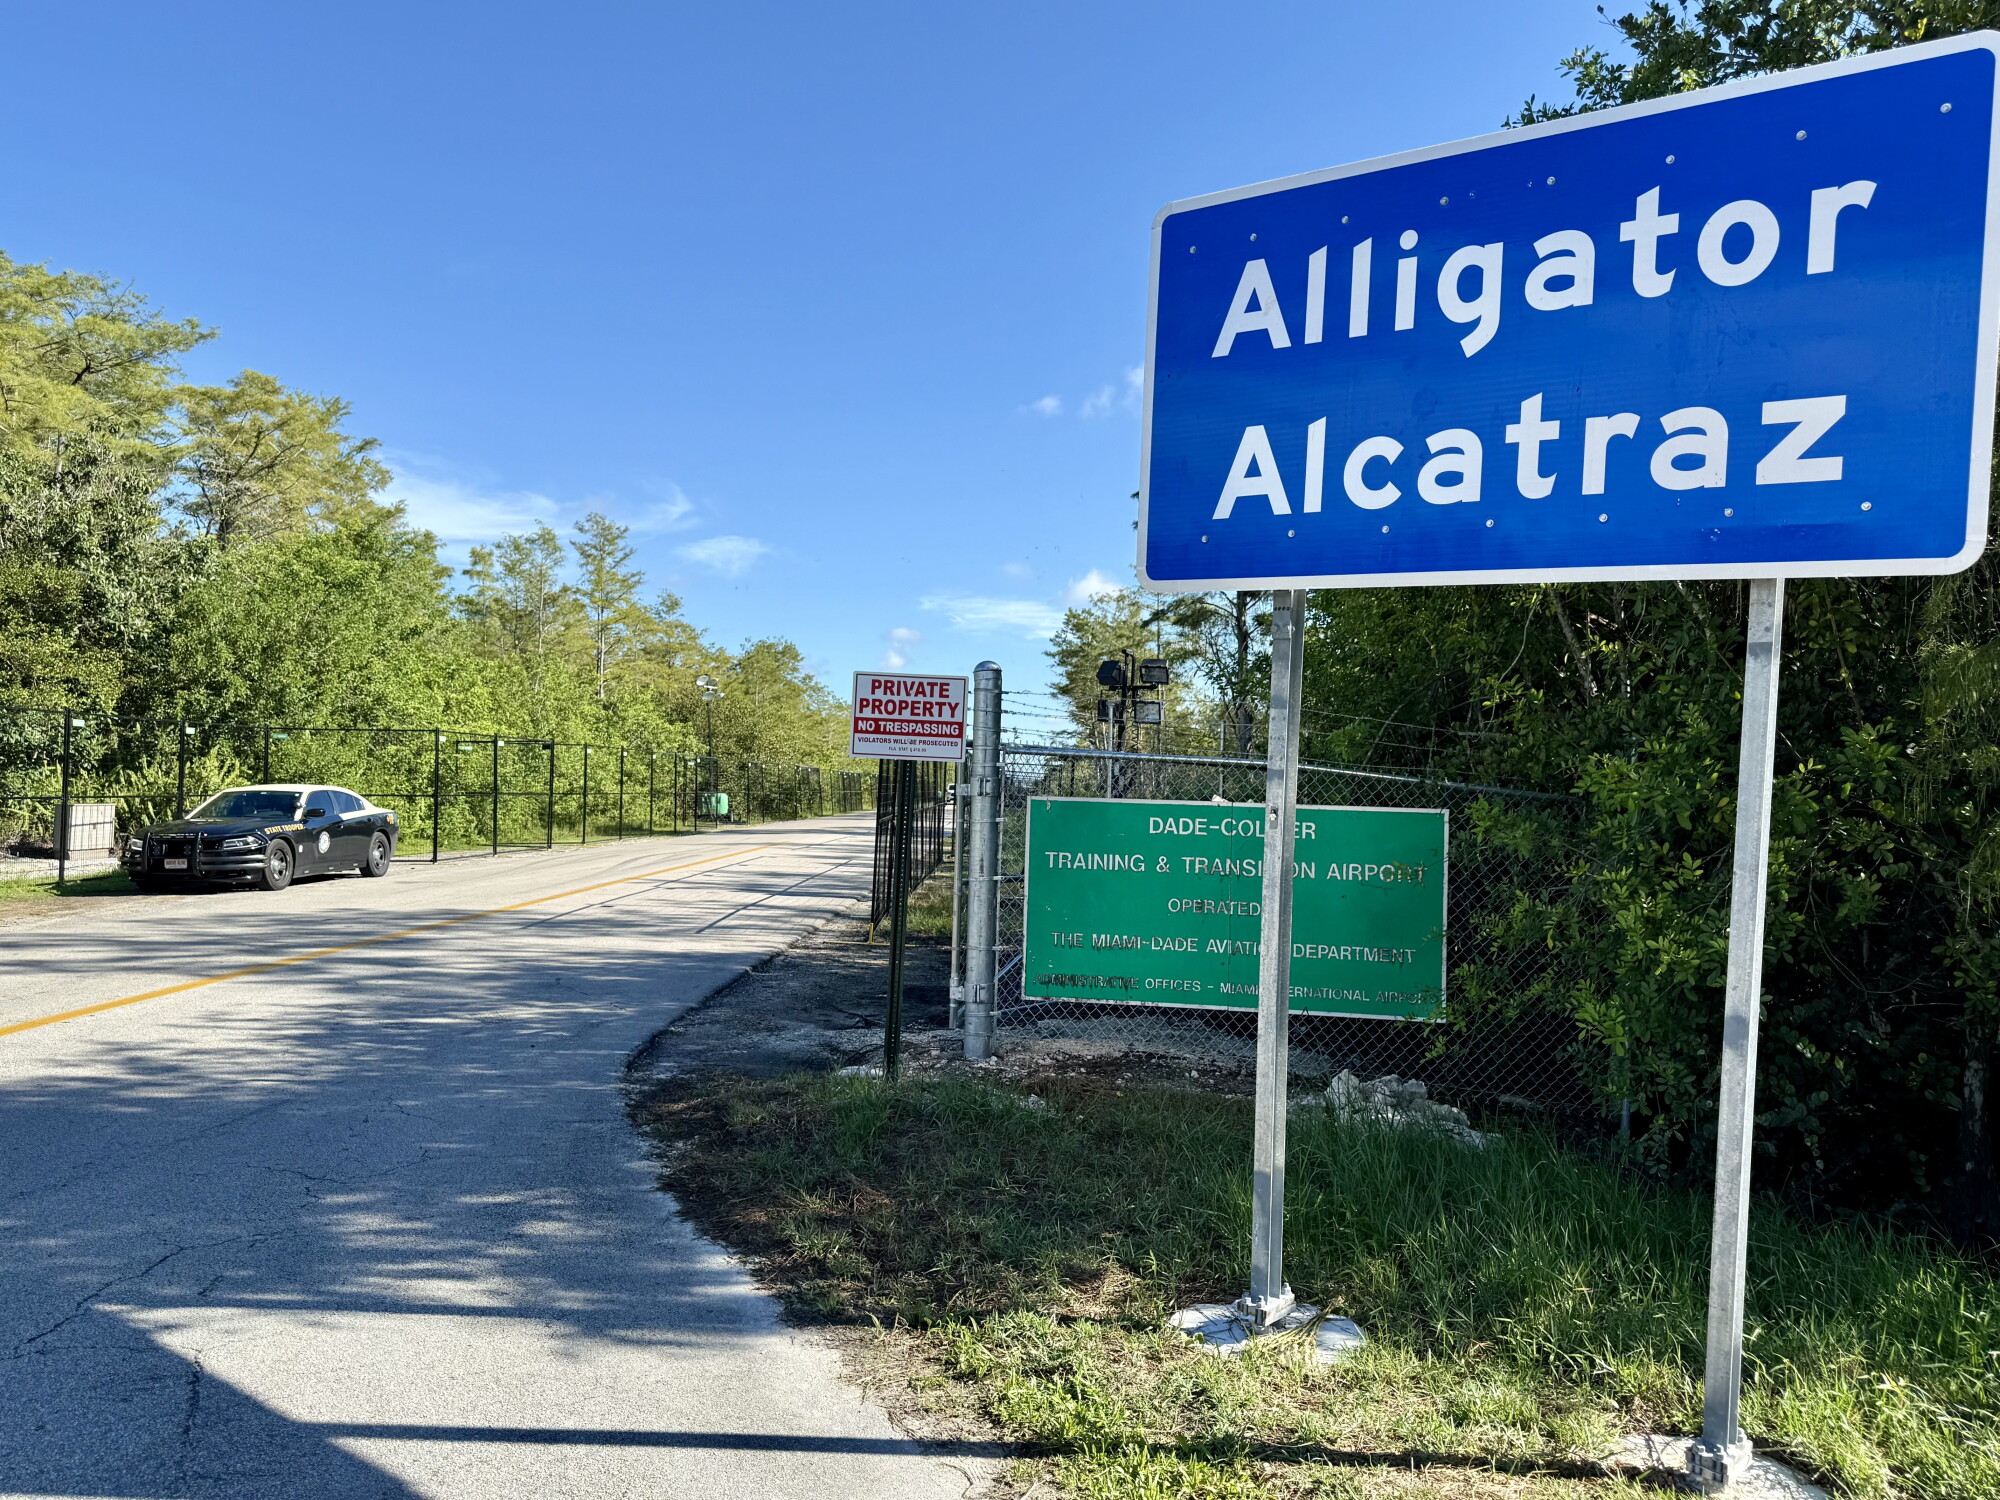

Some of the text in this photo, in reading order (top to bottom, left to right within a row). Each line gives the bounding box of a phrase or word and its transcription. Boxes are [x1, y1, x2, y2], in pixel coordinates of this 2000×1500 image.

[1211, 180, 1877, 358] Alligator
[1212, 391, 1847, 520] Alcatraz
[871, 678, 950, 699] PRIVATE
[858, 697, 960, 718] PROPERTY
[857, 720, 960, 735] NO TRESPASSING
[857, 736, 892, 744] VIOLATORS
[909, 738, 917, 746] BE
[918, 739, 959, 747] PROSECUTED
[264, 825, 283, 835] STATE
[1149, 816, 1317, 841] DADE-COLER
[1044, 851, 1428, 884] TRAINING & TRANSIN AIRPORT
[1167, 897, 1261, 917] OPERATED
[1051, 931, 1416, 964] THE MIAMI-DADE AVIATI DEPARTMENT
[1033, 972, 1139, 990] ADMINISTRATIVE
[1145, 977, 1201, 992] OFFICES
[1220, 981, 1260, 996] MIAMI
[1288, 986, 1370, 1002] ERNATIONAL
[1375, 990, 1431, 1005] AIRPO
